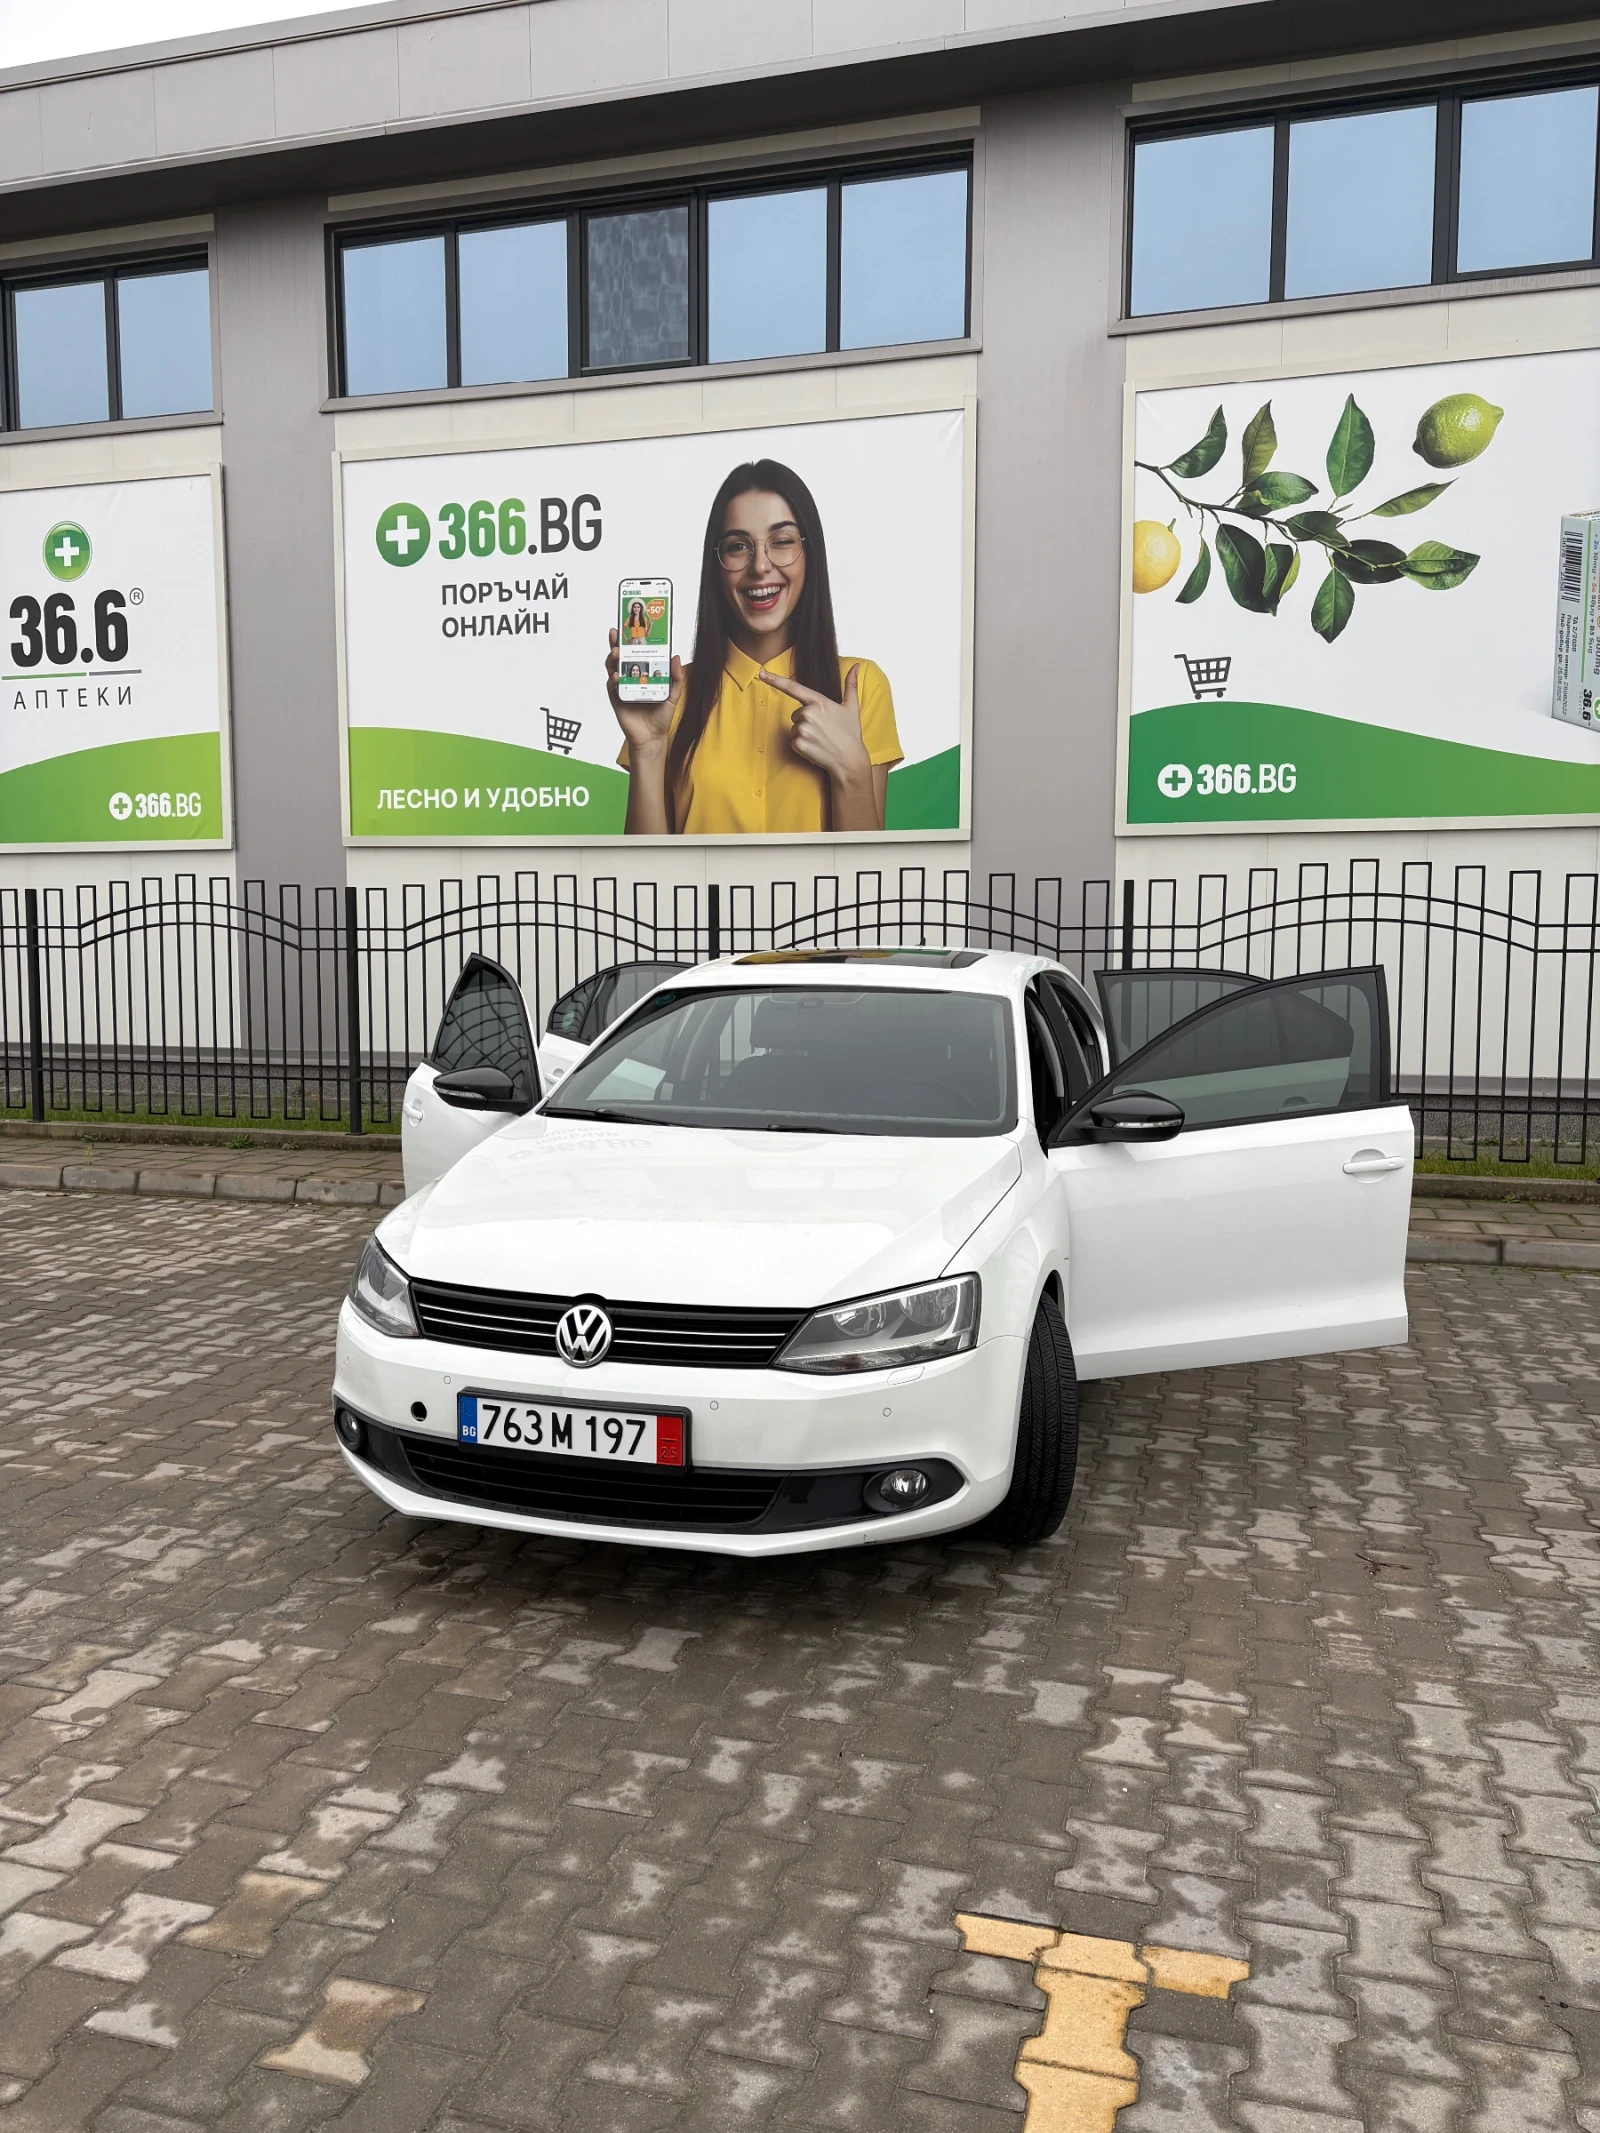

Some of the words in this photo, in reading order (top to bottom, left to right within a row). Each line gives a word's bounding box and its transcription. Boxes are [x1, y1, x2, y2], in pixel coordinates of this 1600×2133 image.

[437, 492, 603, 560] 366.BG
[441, 572, 569, 607] ПОРЪЧАЙ
[441, 610, 550, 639] ОНЛАЙН
[13, 685, 133, 710] АПТЕКИ
[1197, 763, 1297, 795] 366.BG
[135, 792, 201, 819] 366.BG
[377, 787, 459, 811] ЛЕСНО
[463, 788, 481, 809] И
[486, 785, 590, 814] УДОБНО
[462, 1425, 476, 1437] BG
[482, 1405, 543, 1446] 763
[551, 1412, 573, 1449] M
[586, 1416, 647, 1456] 197
